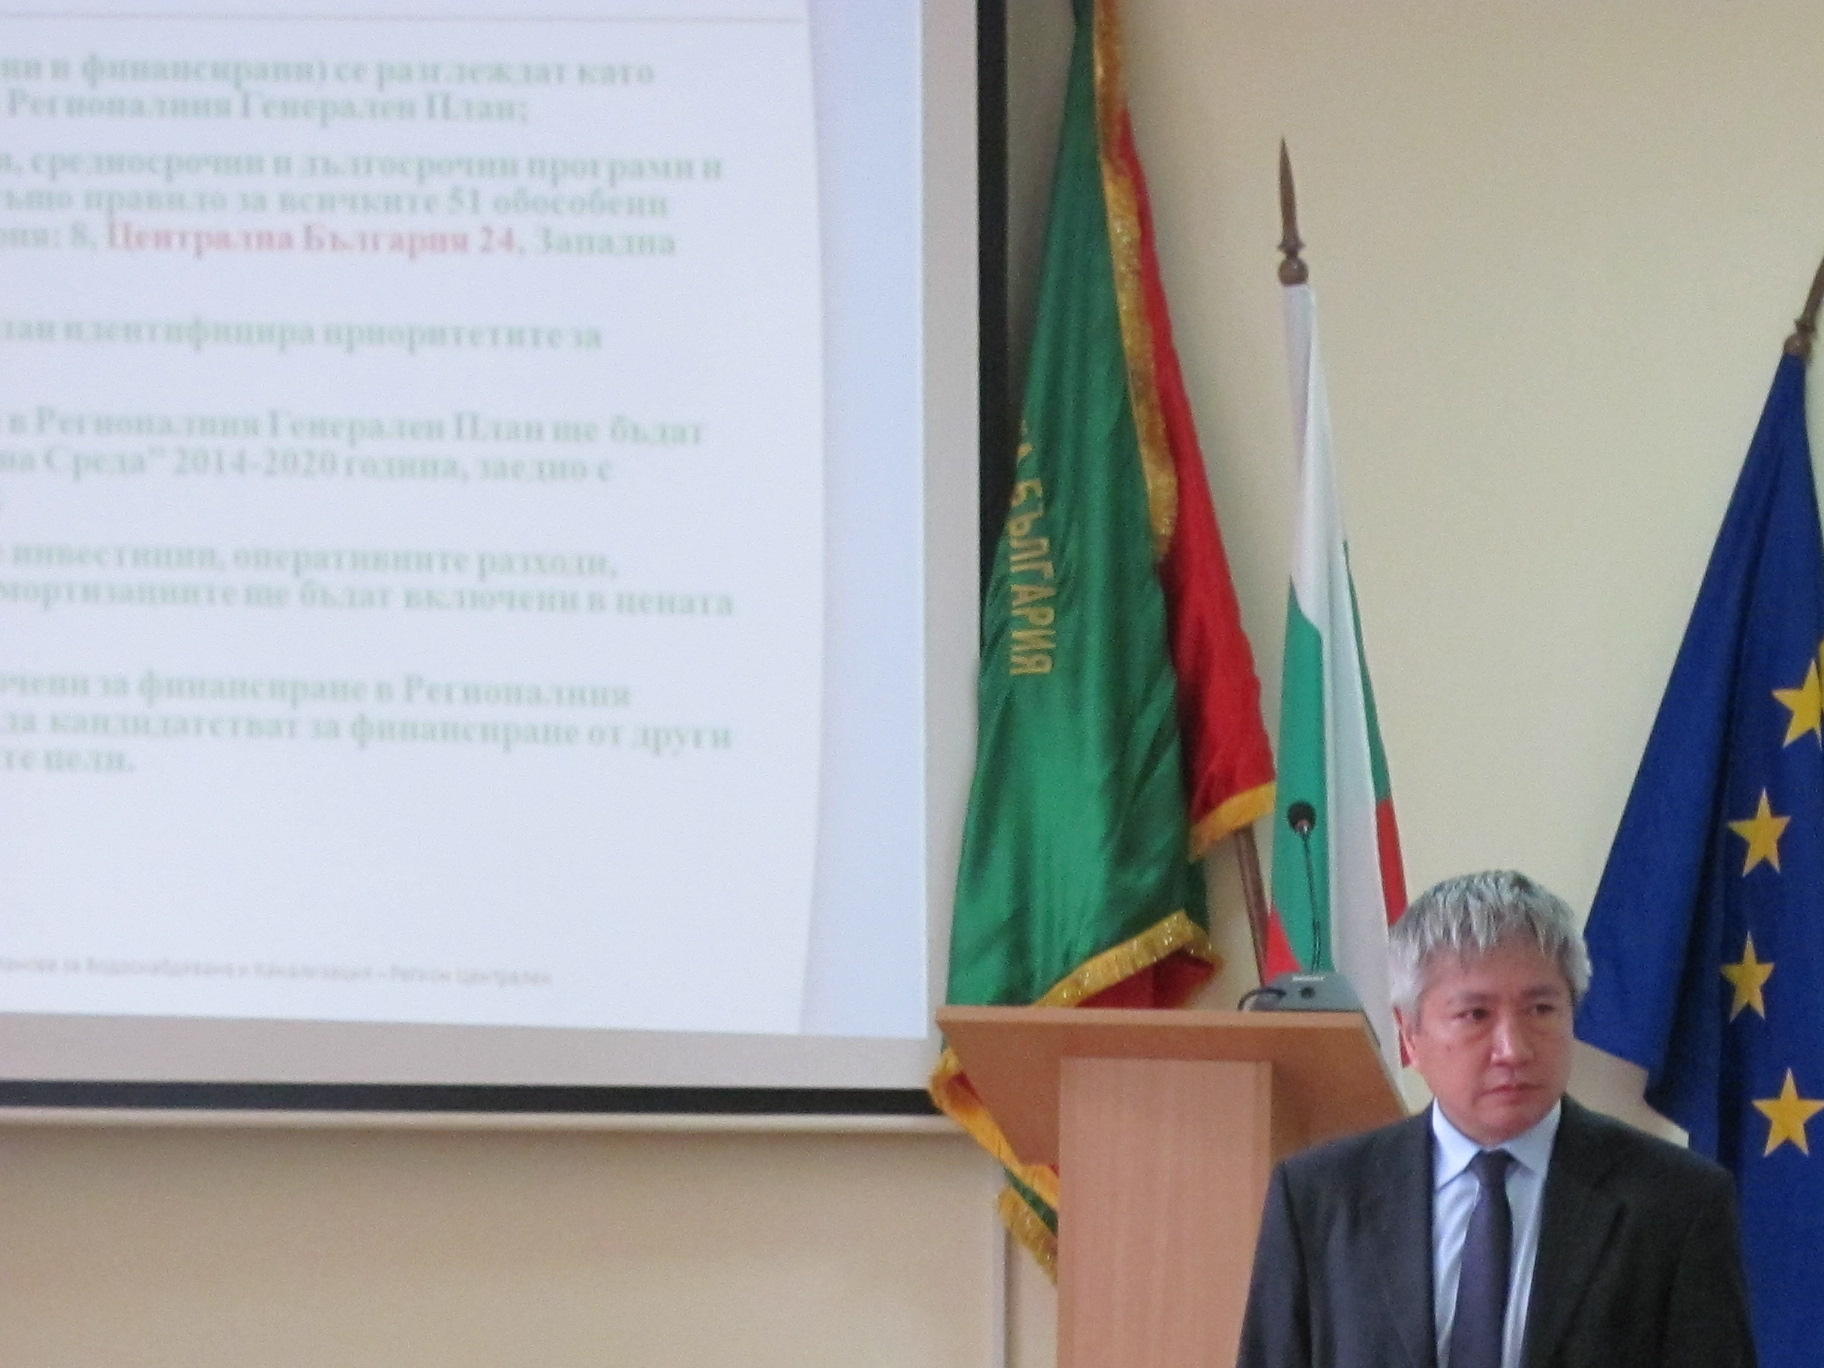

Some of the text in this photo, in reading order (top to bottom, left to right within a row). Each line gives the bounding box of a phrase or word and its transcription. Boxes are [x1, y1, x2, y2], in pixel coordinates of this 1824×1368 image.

[334, 62, 368, 83] се
[376, 62, 566, 92] разглеждат
[577, 63, 656, 86] като
[8, 87, 233, 118] Регионалния
[241, 91, 417, 128] Генерален
[31, 154, 264, 183] средносрочни
[302, 155, 518, 186] дългосрочни
[526, 157, 695, 188] програми
[278, 192, 439, 214] всичките
[449, 187, 481, 214] 51
[493, 188, 669, 218] обособени
[106, 220, 294, 259] Централна
[303, 223, 471, 261] България
[479, 226, 526, 255] 24,
[535, 226, 677, 257] Западна
[64, 313, 314, 352] идентифицира
[323, 323, 564, 354] приоритетите
[35, 404, 260, 437] Регионалния
[269, 409, 445, 447] Генерален
[453, 411, 545, 442] План
[610, 414, 705, 446] бъдат
[174, 448, 338, 477] 2014-2020
[344, 455, 470, 482] година,
[478, 457, 588, 482] заедно
[13, 544, 618, 582] инвестиции, оперативните разходи,
[298, 578, 392, 610] бъдат
[404, 586, 580, 613] включени
[615, 592, 734, 616] цената
[138, 667, 367, 710] финансиране
[404, 674, 633, 707] Регионалния
[50, 711, 299, 740] кандидатстват
[350, 712, 580, 752] финансиране
[587, 722, 624, 746] от
[630, 723, 733, 756] други
